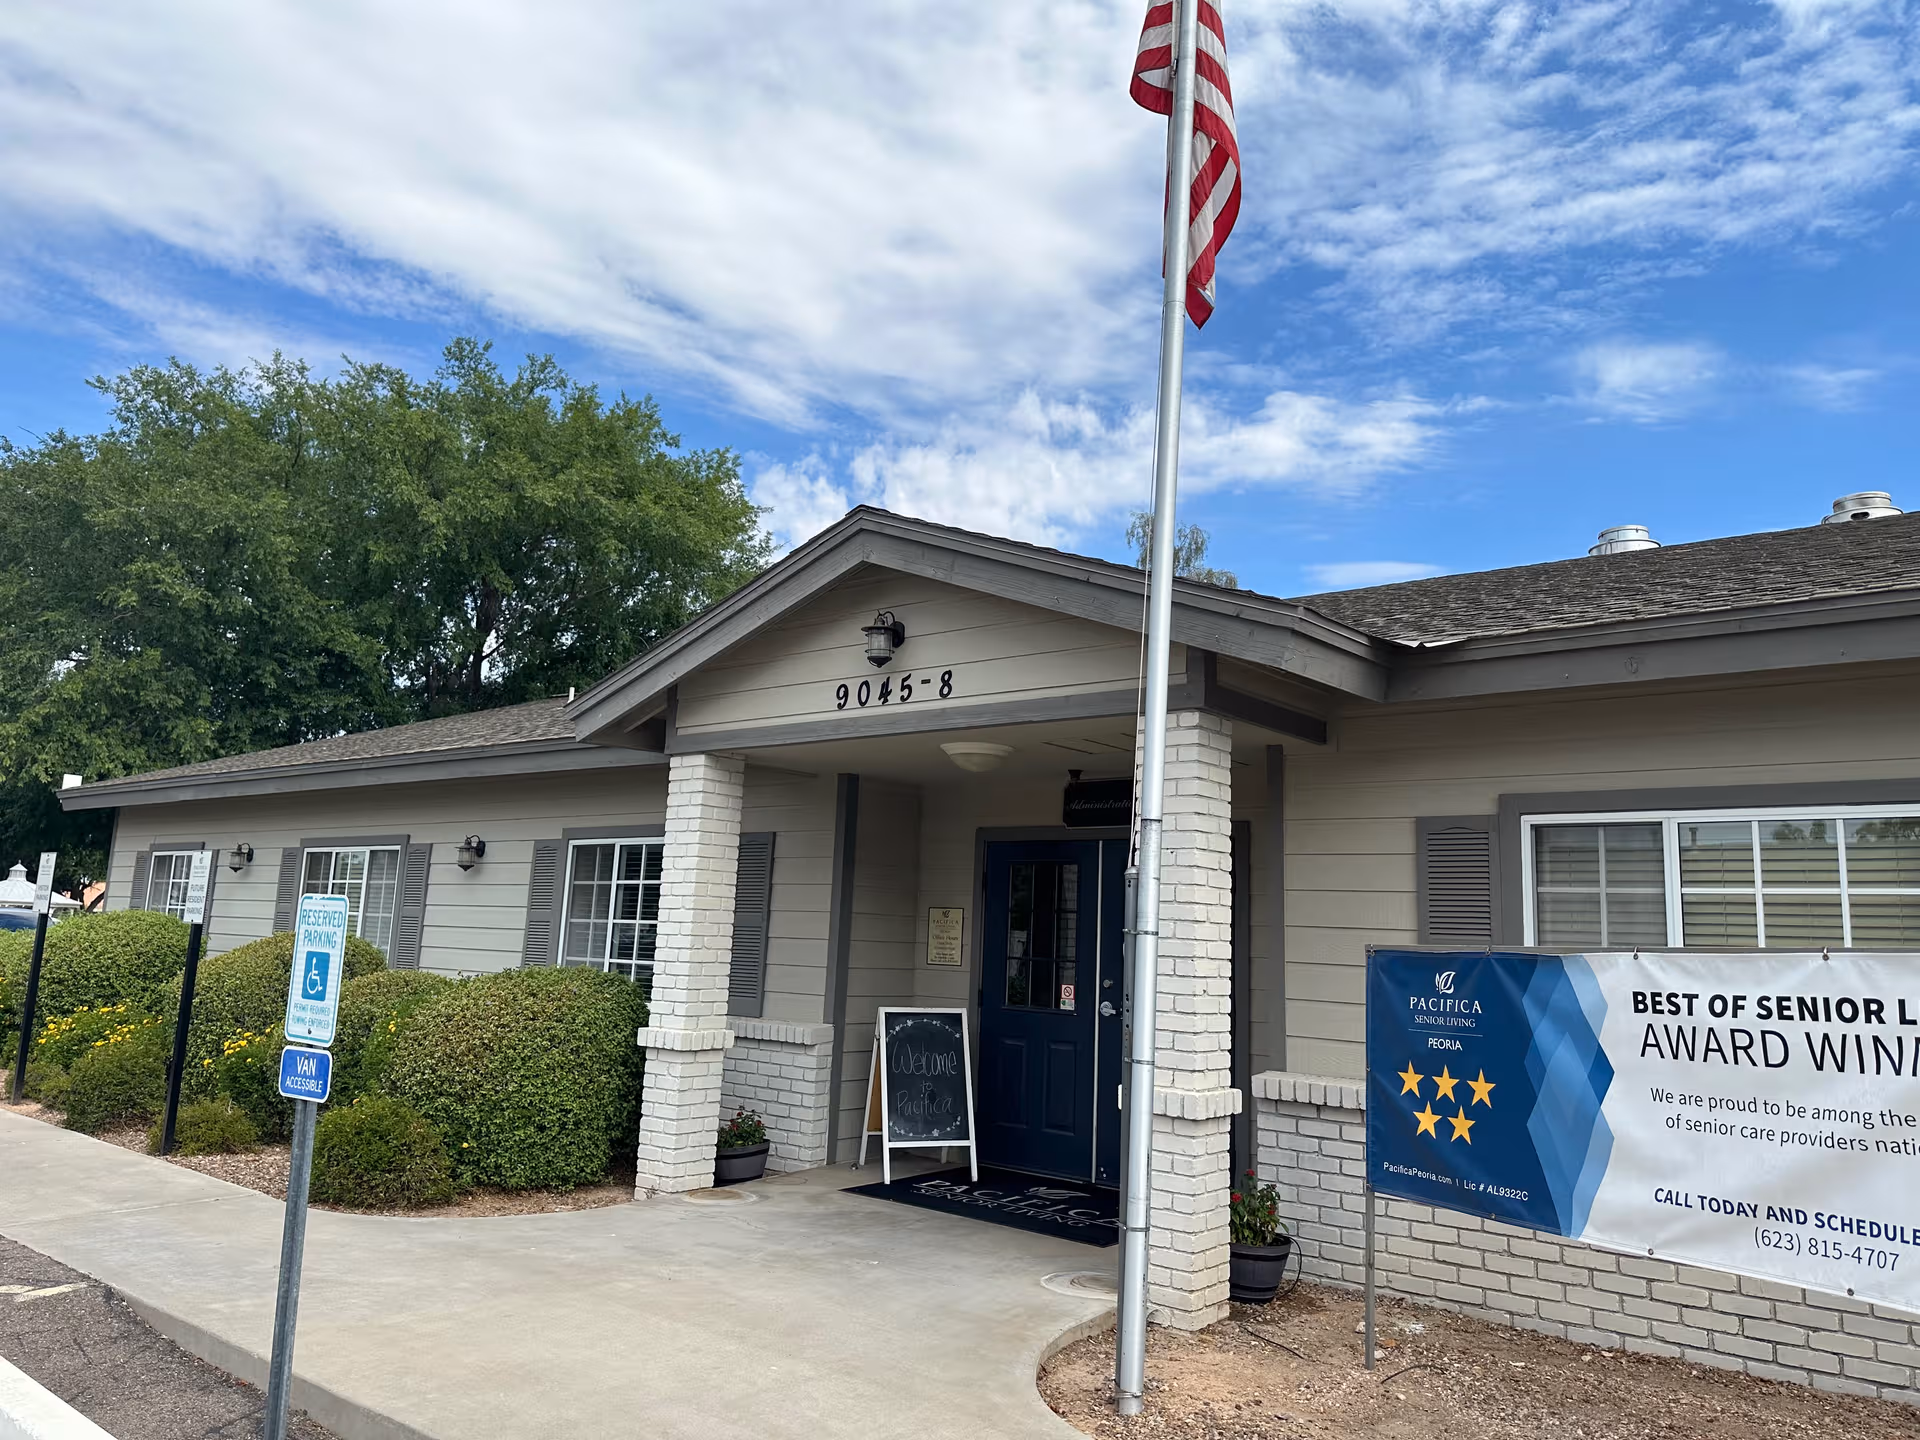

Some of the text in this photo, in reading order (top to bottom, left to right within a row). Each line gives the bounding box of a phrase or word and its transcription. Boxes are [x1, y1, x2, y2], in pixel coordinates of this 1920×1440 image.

[836, 669, 953, 710] 9045-8
[301, 909, 344, 928] RESERVED
[303, 929, 337, 949] PARKING
[294, 1002, 331, 1017] PERMIT REQUIRED
[1409, 996, 1482, 1014] PACIFICA
[1632, 990, 1699, 1017] BEST
[1708, 993, 1747, 1018] OF
[1756, 995, 1887, 1025] SENIOR
[308, 1017, 330, 1030] ENFORCED
[1414, 1014, 1476, 1028] SENIOR LIVING
[892, 1040, 958, 1077] Welcome
[1428, 1038, 1463, 1051] PEORIA
[1640, 1022, 1790, 1069] AWARD
[297, 1055, 317, 1077] VAN
[285, 1075, 323, 1093] ACCESSIBLE
[920, 1080, 933, 1093] to
[896, 1090, 953, 1118] Pacifica
[1650, 1087, 1917, 1130] We are proud to be among the
[1665, 1114, 1920, 1156] of senior care providers nati
[1383, 1161, 1453, 1185] PacificaPeoria.com
[1463, 1179, 1477, 1191] Lic
[1486, 1184, 1529, 1201] AL9322C
[914, 1188, 1089, 1228] SENIOR LIVING
[1654, 1187, 1920, 1247] CALL TODAY AND SCHEDULE
[1754, 1226, 1900, 1272] (623) 815-4707
